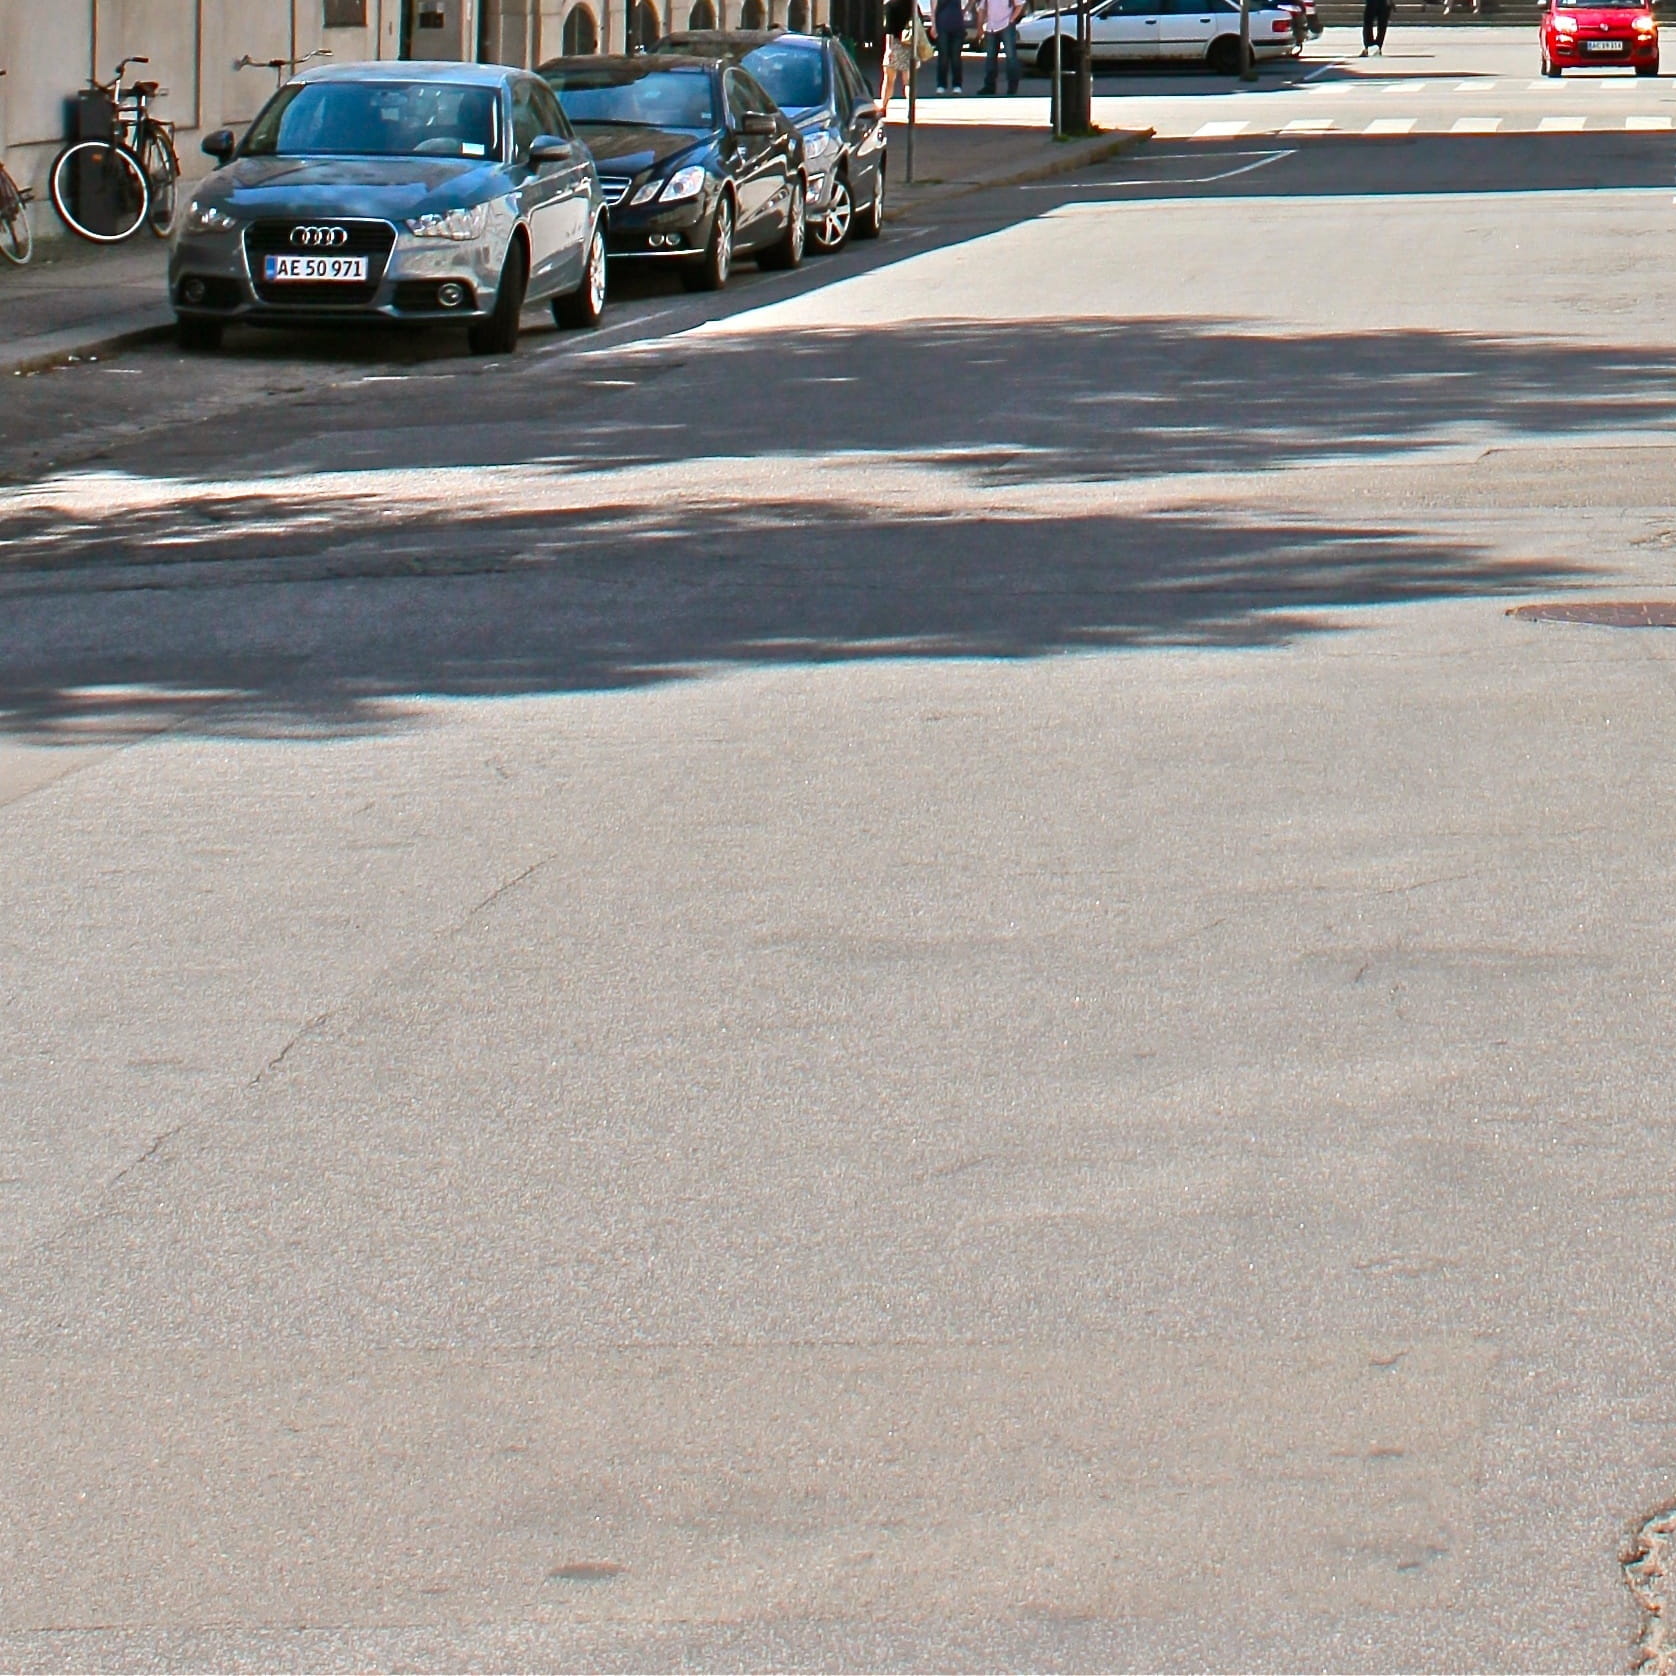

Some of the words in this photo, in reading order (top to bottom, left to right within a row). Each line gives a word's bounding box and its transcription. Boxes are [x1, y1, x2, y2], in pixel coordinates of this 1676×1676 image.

[278, 259, 300, 277] AE
[306, 259, 327, 277] 50
[331, 259, 361, 277] 971
